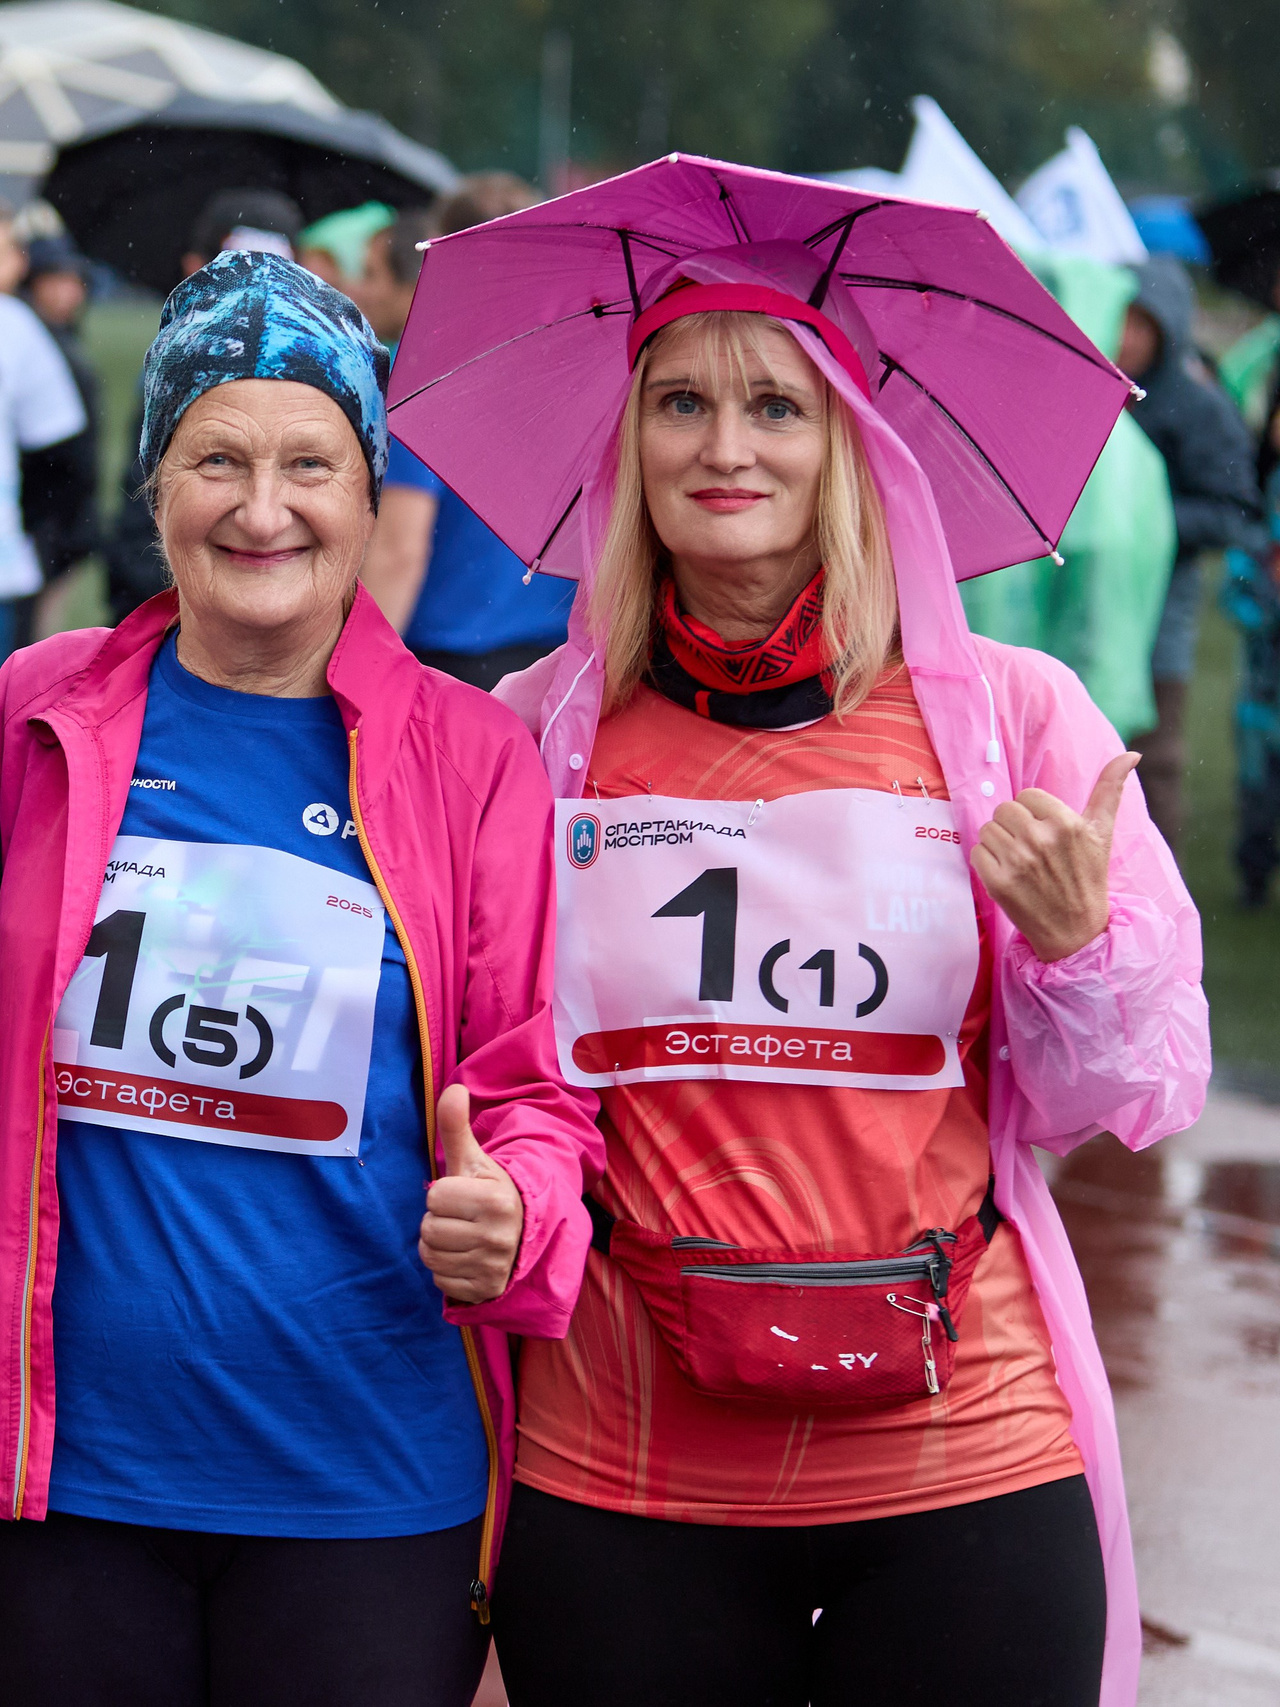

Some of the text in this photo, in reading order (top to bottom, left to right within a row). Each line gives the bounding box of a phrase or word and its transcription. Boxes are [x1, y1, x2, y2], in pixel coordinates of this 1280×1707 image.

[604, 819, 747, 840] СПАРТАКИАДА
[604, 831, 694, 851] МОСПРОМ
[915, 826, 961, 845] 2025
[326, 895, 373, 919] 2025
[650, 866, 889, 1019] 1 (1)
[84, 908, 146, 1050] 1
[148, 993, 274, 1081] (5)
[664, 1030, 853, 1063] Эстафета
[55, 1071, 236, 1121] Эстафета
